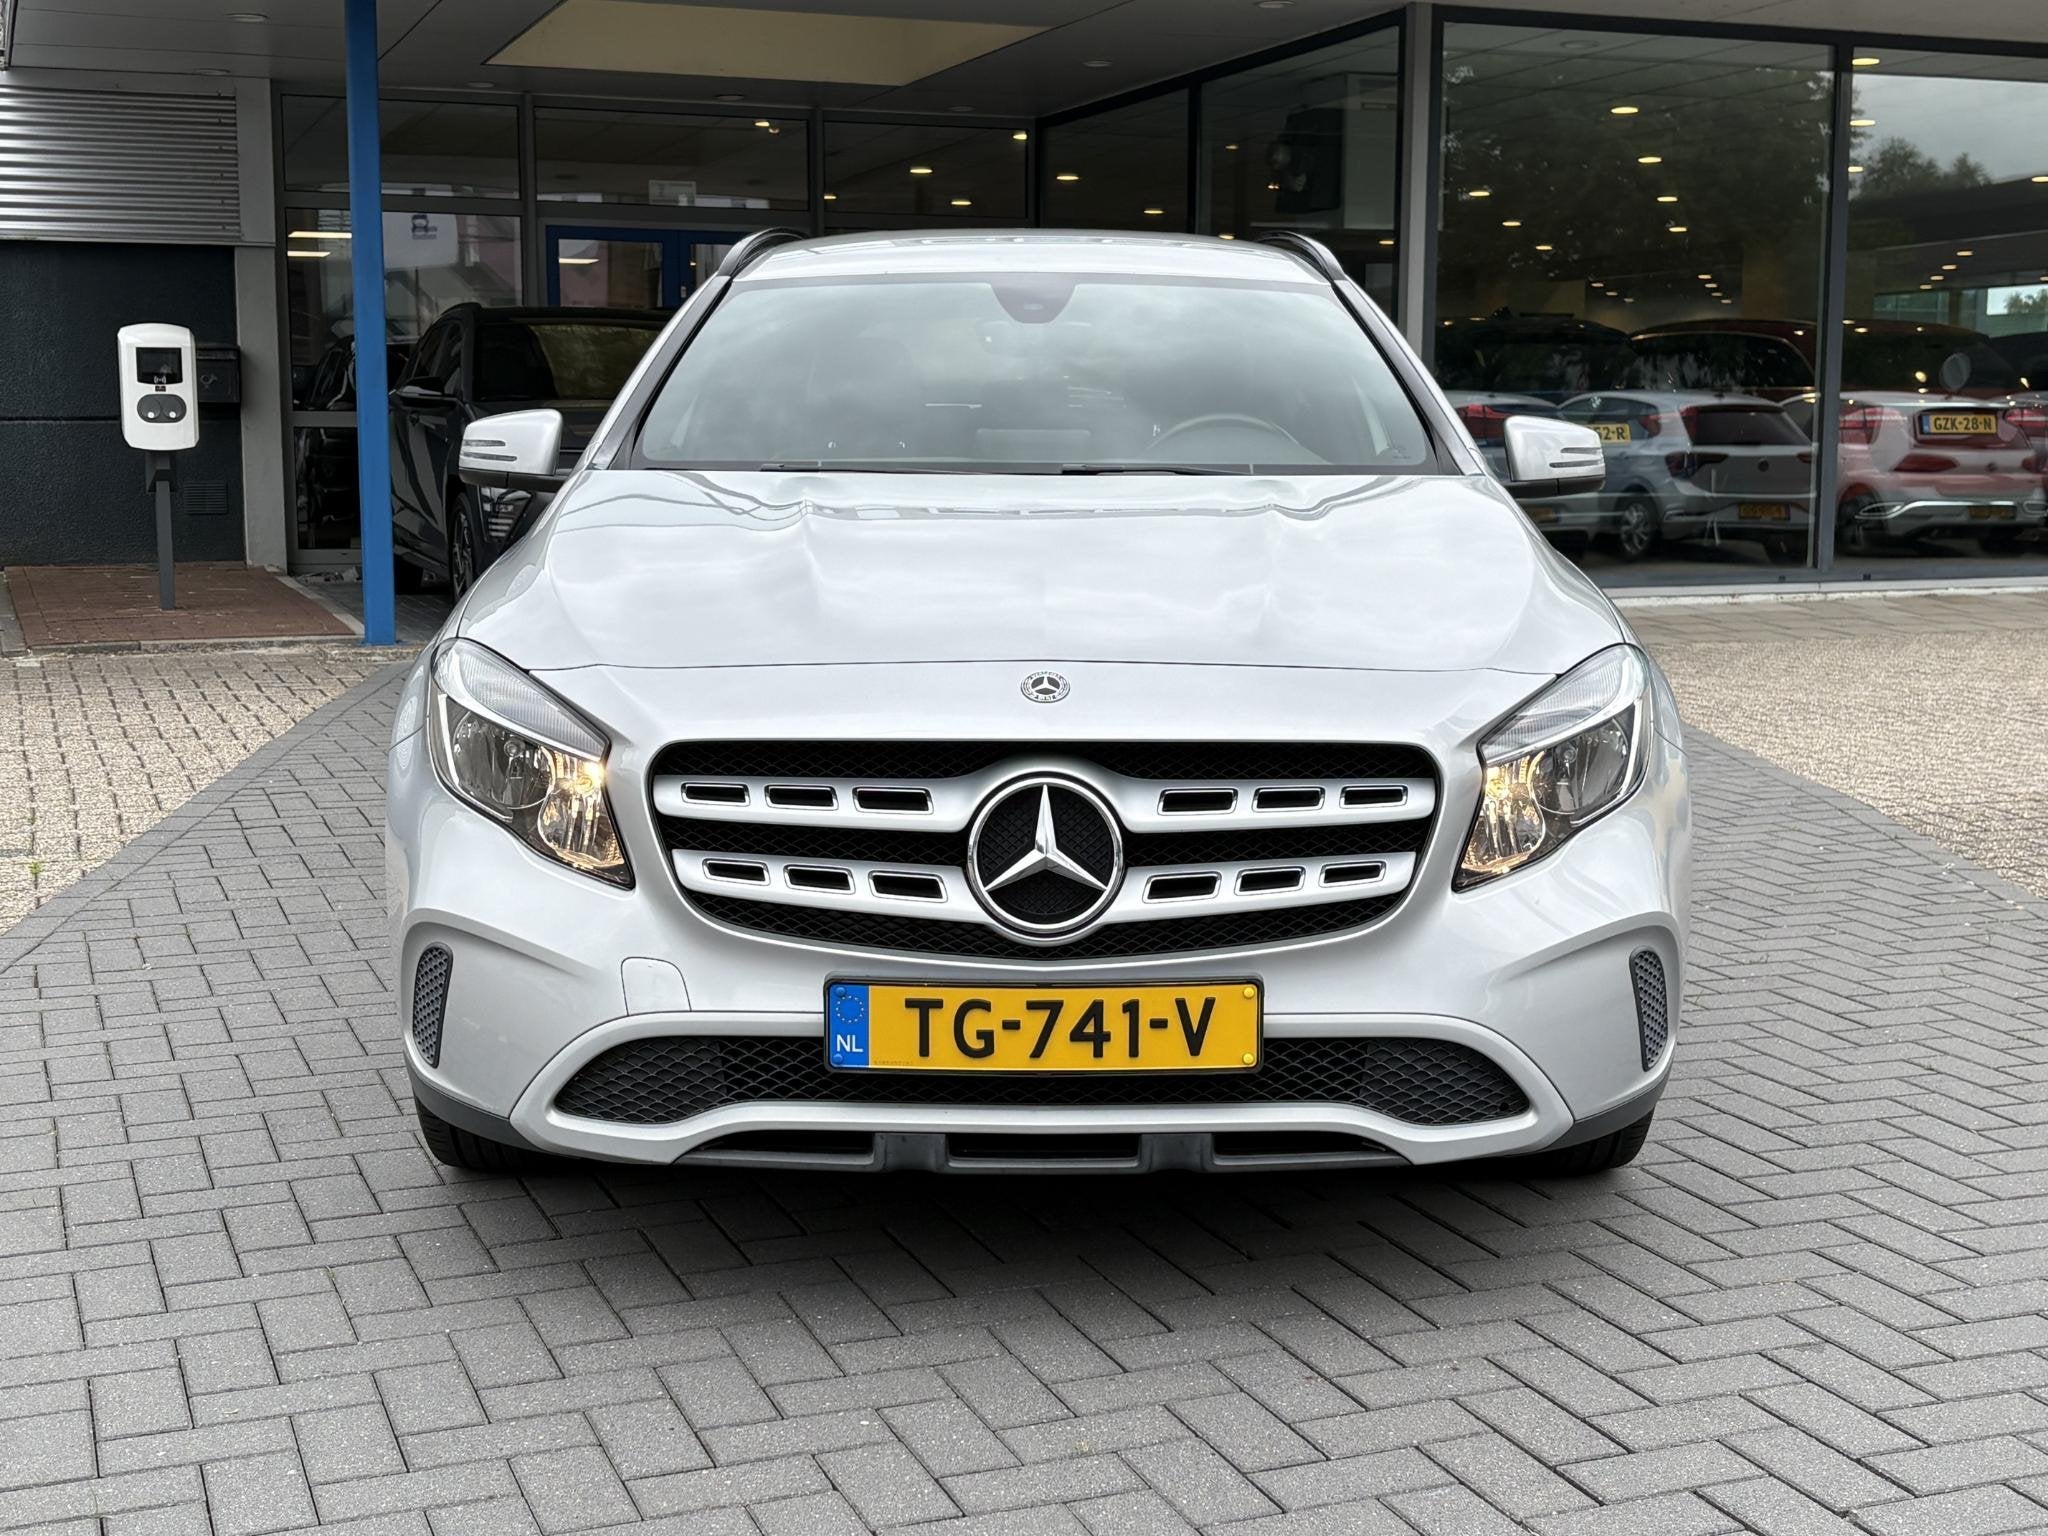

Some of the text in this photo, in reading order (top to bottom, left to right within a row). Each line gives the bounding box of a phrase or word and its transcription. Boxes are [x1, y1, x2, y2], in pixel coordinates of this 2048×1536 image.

[1934, 417, 1992, 430] GZK-28-N
[905, 997, 1216, 1059] TG-741-V
[836, 1034, 864, 1053] NL
